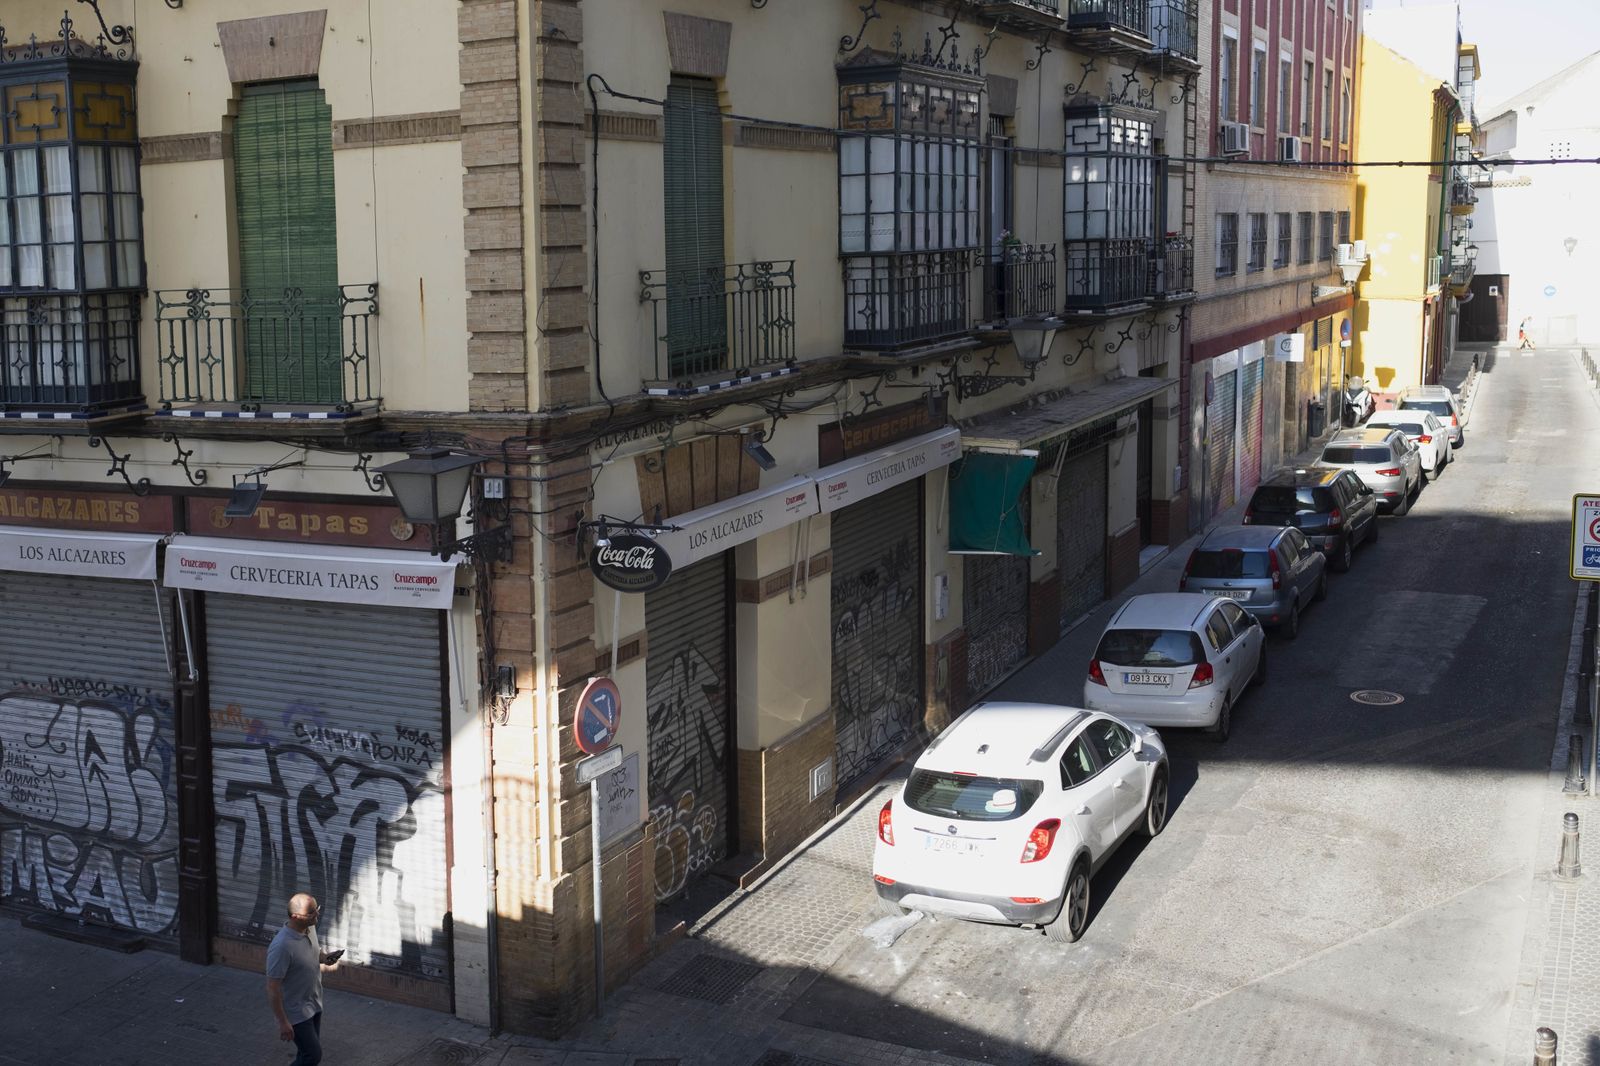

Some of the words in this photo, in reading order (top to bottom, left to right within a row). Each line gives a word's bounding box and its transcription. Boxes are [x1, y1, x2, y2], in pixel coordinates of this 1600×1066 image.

[866, 460, 906, 486] CERVECERIA
[906, 452, 927, 473] TAPAS
[0, 496, 140, 523] ALCAZARES
[254, 507, 369, 536] Tapas
[689, 531, 708, 550] LOS
[710, 509, 764, 543] ALCAZARES
[19, 545, 43, 561] LOS
[47, 547, 126, 565] ALCAZARES
[180, 557, 217, 571] Cruzcampo
[230, 565, 323, 587] CERVECERIA
[327, 572, 379, 591] TAPAS
[394, 572, 438, 586] Cruzcampo
[1130, 674, 1151, 683] 0913
[1152, 675, 1168, 684] CKX
